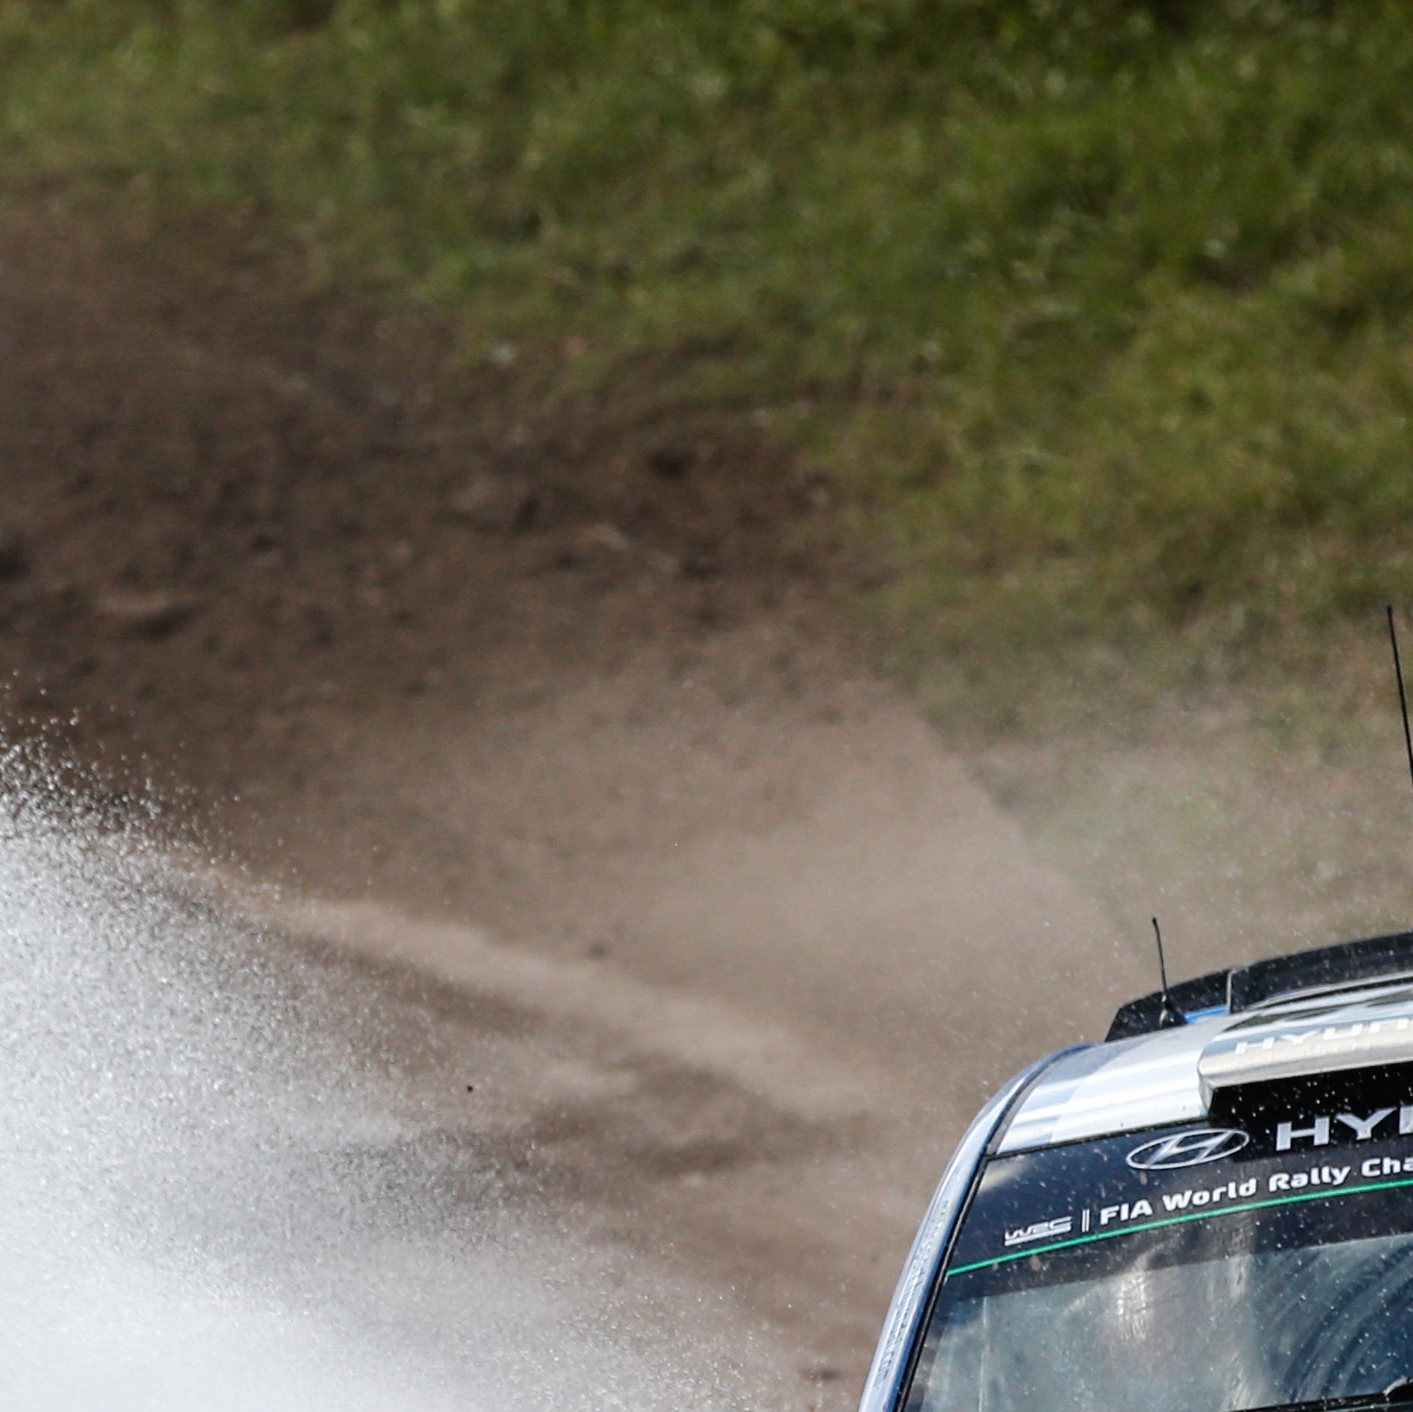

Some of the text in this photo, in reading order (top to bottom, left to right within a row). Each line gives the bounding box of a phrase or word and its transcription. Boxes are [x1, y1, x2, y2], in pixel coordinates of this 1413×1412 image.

[1004, 1216, 1073, 1246] WRC
[1099, 1203, 1153, 1226] FIA
[1162, 1178, 1257, 1211] World
[1268, 1165, 1351, 1192] Rally
